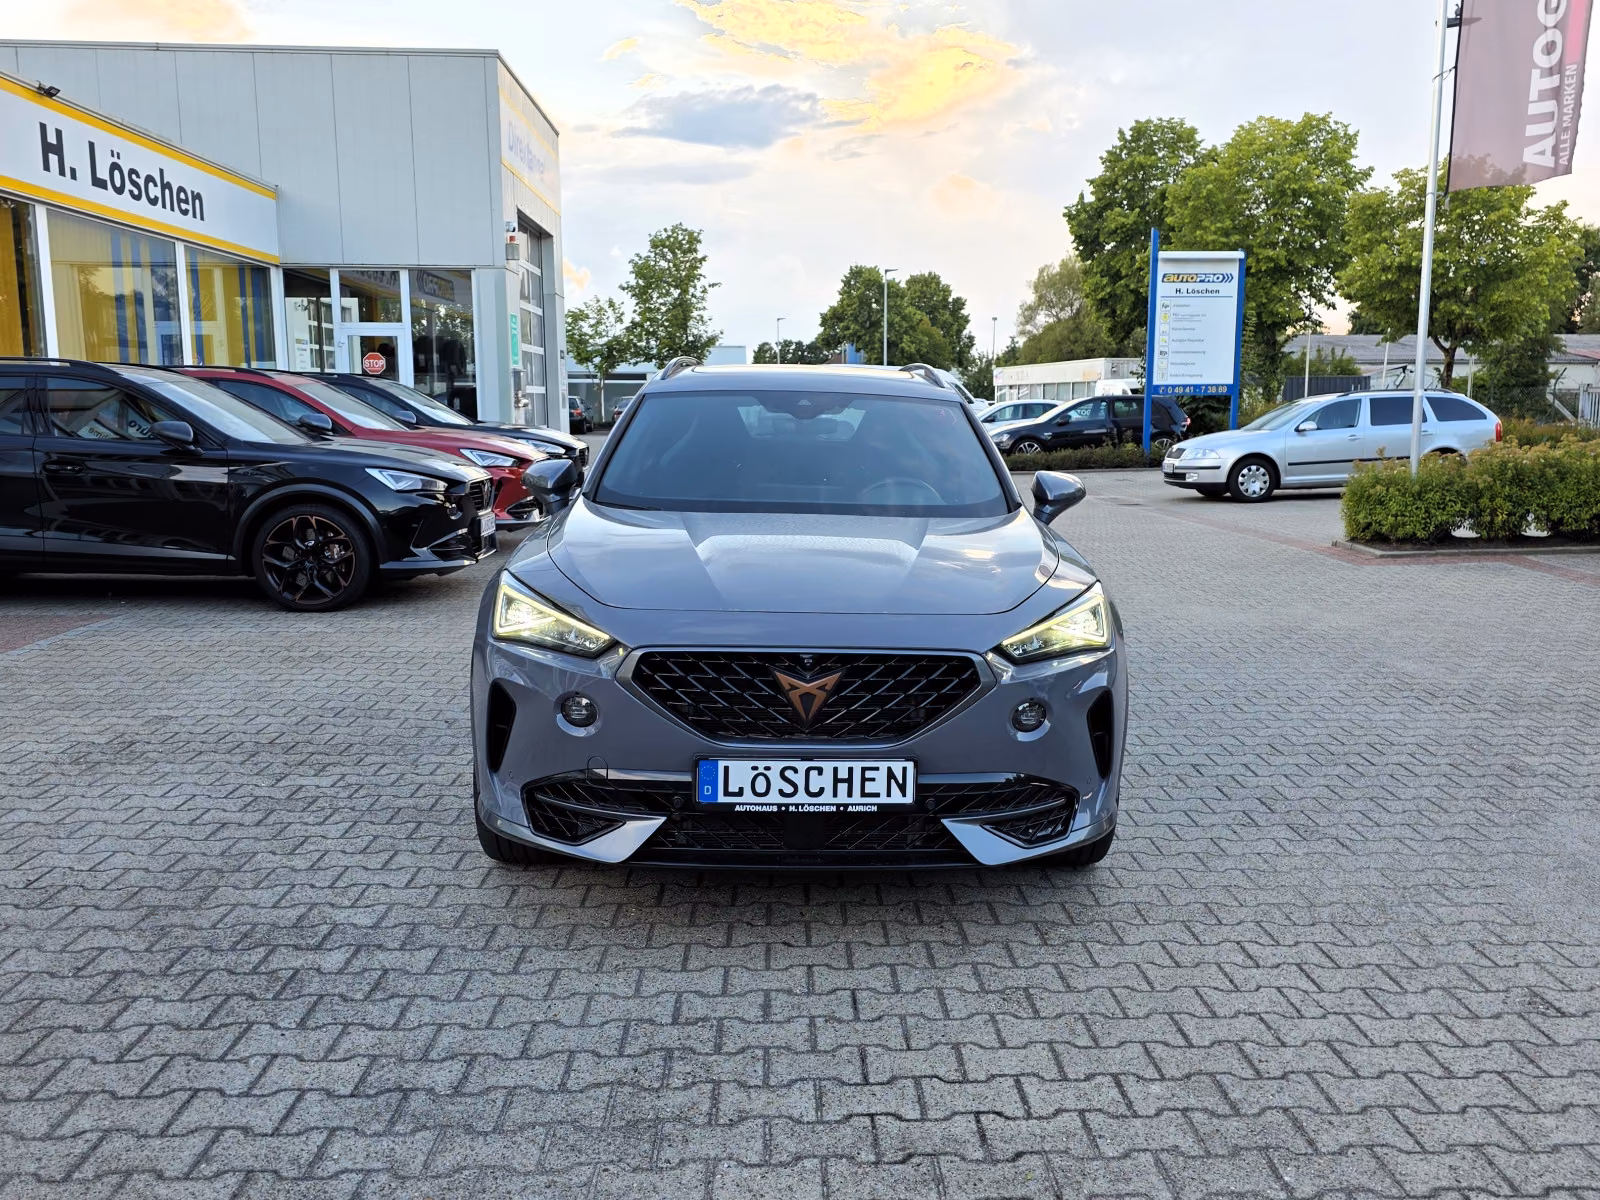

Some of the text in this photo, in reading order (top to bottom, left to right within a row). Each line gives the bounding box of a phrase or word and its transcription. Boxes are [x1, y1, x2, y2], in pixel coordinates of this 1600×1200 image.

[1558, 64, 1578, 166] ALLE MARKEN
[39, 121, 205, 222] H. Löschen
[364, 359, 385, 368] STOP
[704, 765, 908, 798] D LÖSCHEN
[734, 803, 878, 812] AUTOHAUS H. LÖSCHEN AURICH
